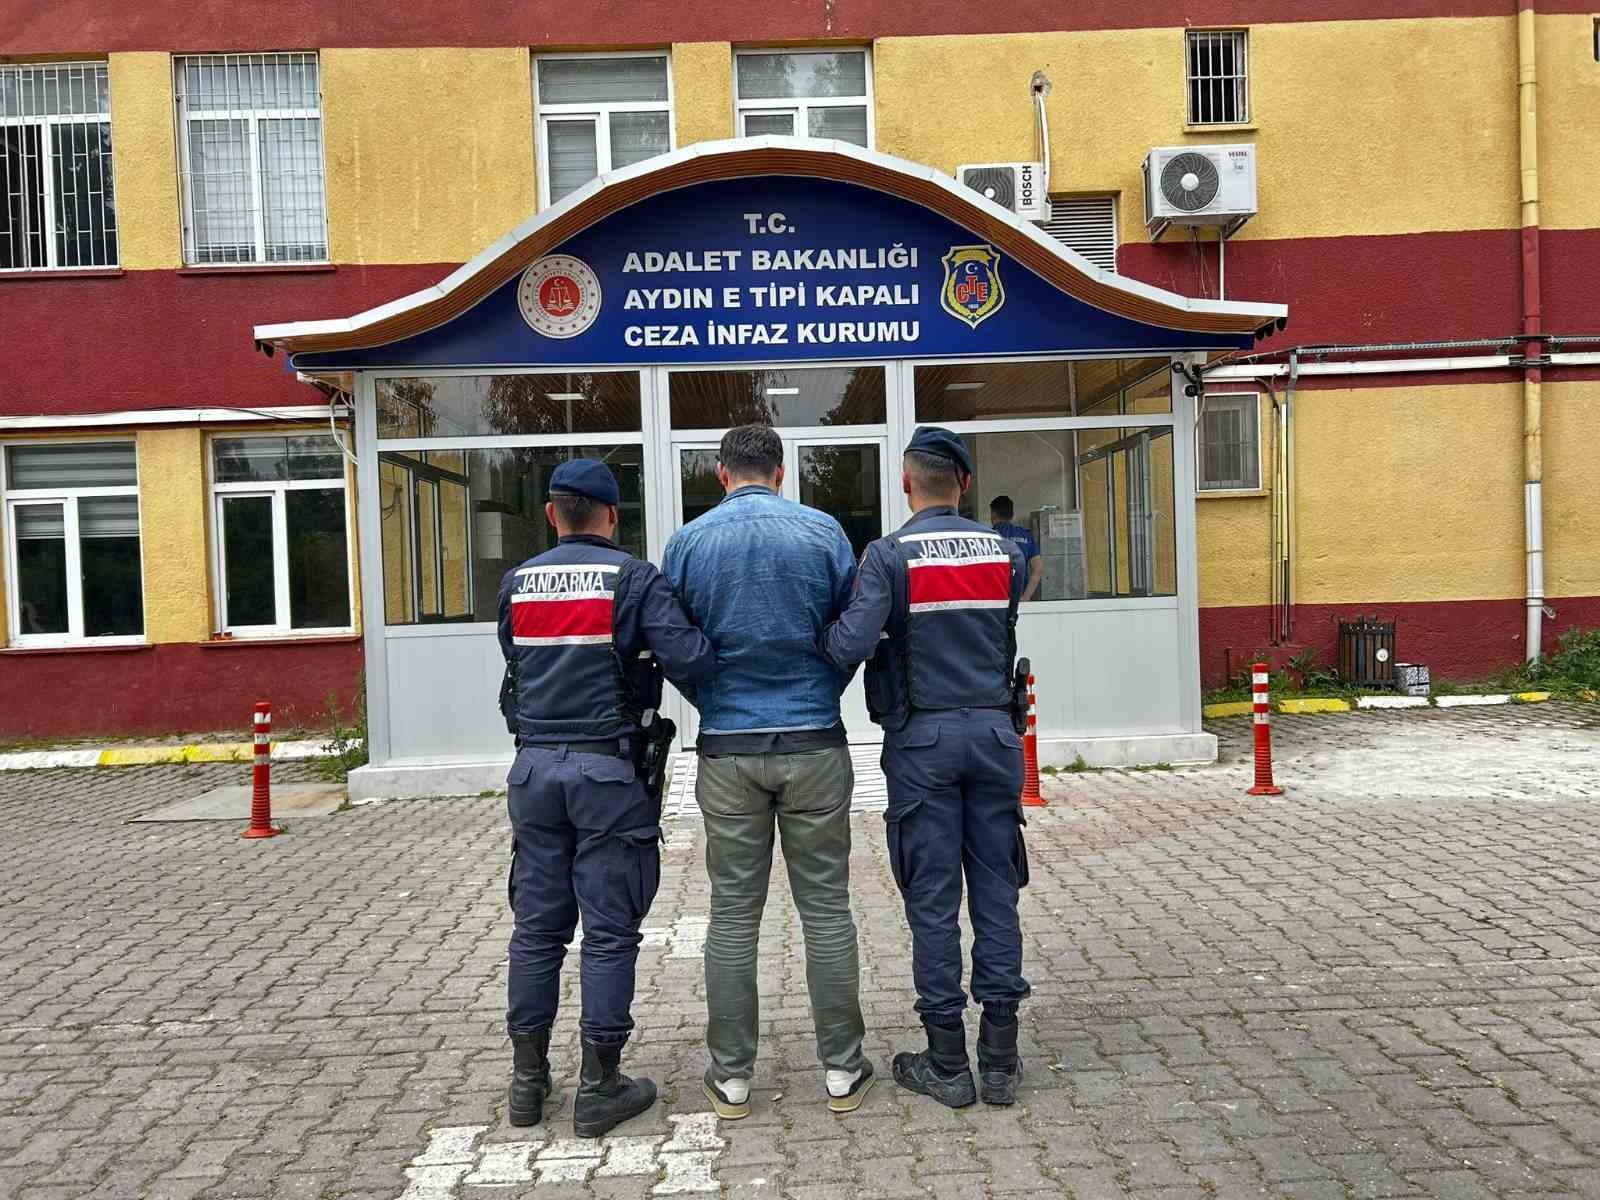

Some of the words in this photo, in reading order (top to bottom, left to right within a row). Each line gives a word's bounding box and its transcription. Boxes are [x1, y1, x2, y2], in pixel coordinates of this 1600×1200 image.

[1022, 165, 1032, 206] BOSCH
[743, 212, 796, 234] T.C.
[622, 250, 742, 273] ADALET
[751, 242, 919, 271] BAKANLIĞI
[623, 287, 714, 310] AYDIN
[723, 287, 741, 308] E
[749, 281, 806, 308] TİPİ
[815, 284, 920, 307] KAPALI
[955, 275, 988, 304] CTE
[624, 324, 700, 347] CEZA
[707, 320, 789, 346] İNFAZ
[797, 320, 921, 344] KURUMU
[919, 537, 1003, 559] JANDARMA
[518, 571, 605, 594] JANDARMA
